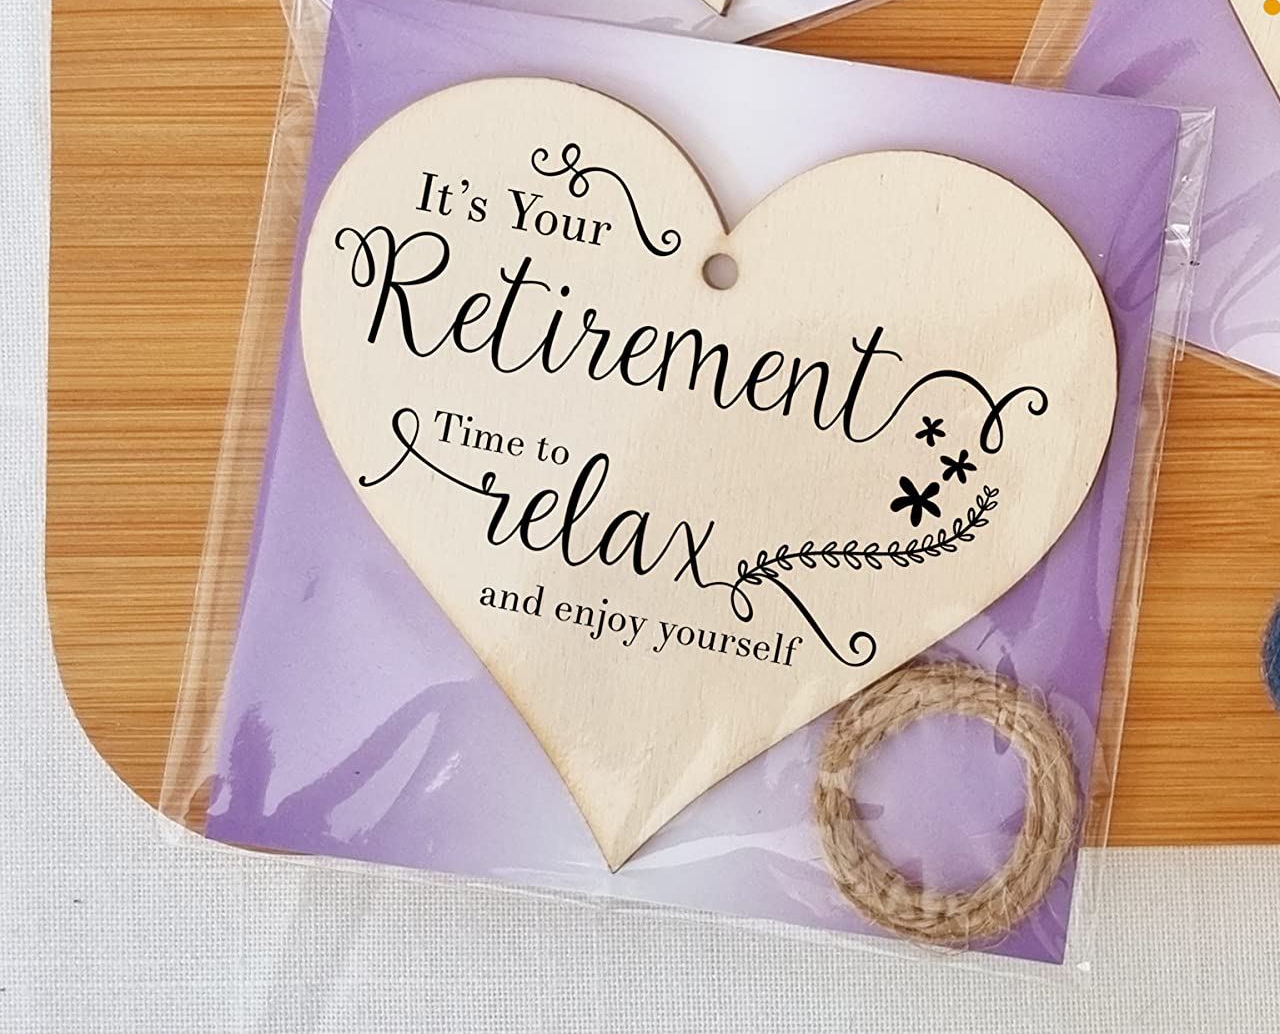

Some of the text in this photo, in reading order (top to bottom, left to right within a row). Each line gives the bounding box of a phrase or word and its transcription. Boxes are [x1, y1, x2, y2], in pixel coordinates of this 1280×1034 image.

[415, 171, 612, 246] It’s Your
[334, 225, 1049, 455] Retirement
[434, 410, 570, 465] Time to
[456, 450, 732, 604] relax
[479, 584, 804, 667] and enjoy yourself
